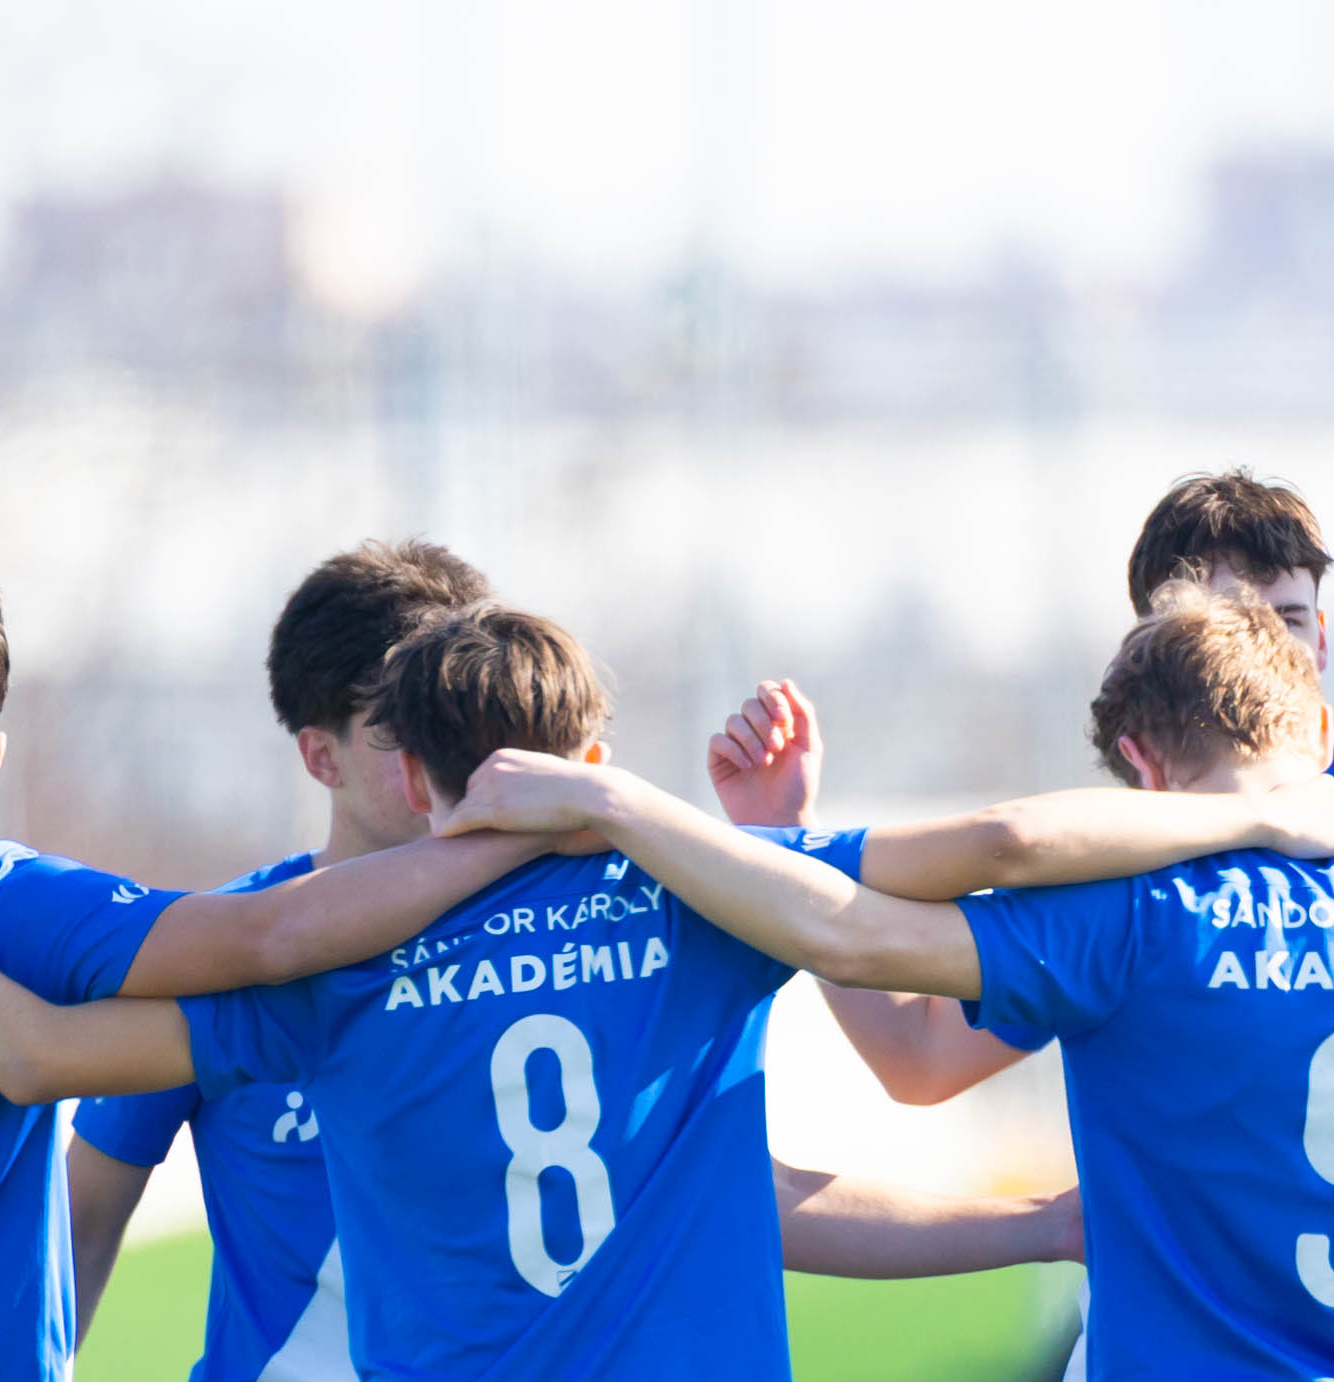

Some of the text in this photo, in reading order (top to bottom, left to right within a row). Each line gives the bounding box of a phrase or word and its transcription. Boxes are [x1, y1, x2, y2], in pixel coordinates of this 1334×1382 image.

[384, 936, 670, 1011] AKADÉMIA
[390, 907, 536, 972] SÁOR
[490, 1013, 616, 1298] 8
